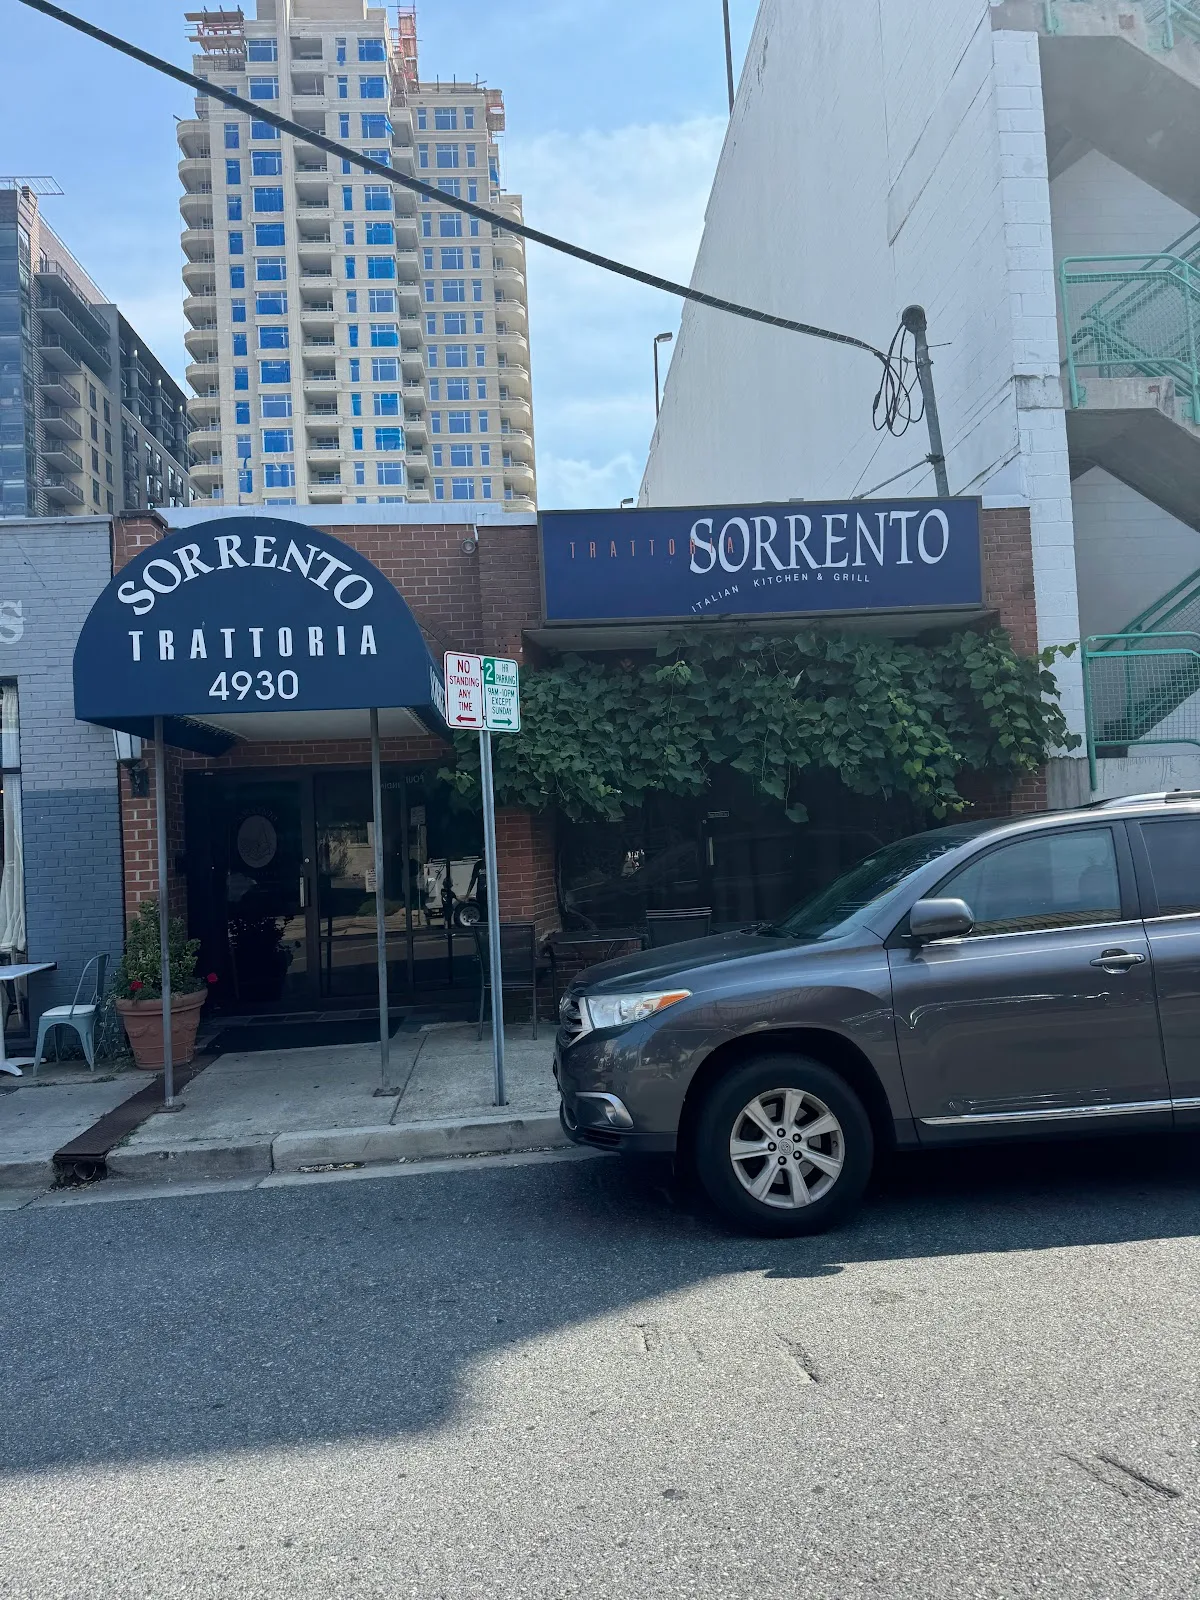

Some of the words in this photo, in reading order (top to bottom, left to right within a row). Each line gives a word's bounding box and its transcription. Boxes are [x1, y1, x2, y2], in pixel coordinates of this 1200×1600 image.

[570, 537, 734, 559] TRATTORIA
[689, 508, 950, 574] SORRENTO
[117, 534, 374, 616] SORRENTO
[691, 585, 739, 613] ITALIAN
[753, 573, 808, 587] KITCHEN
[816, 572, 823, 581] &
[833, 573, 870, 583] GRILL
[128, 625, 377, 662] TRATTORIA
[457, 659, 471, 674] NO
[485, 662, 494, 681] 2
[501, 663, 509, 673] HR
[208, 670, 299, 701] 4930
[449, 675, 480, 688] STANDING
[496, 673, 516, 685] PARKING
[458, 689, 472, 699] ANY
[491, 697, 512, 706] EXCEPT
[458, 701, 473, 712] TIME
[491, 706, 513, 715] SUNDAY
